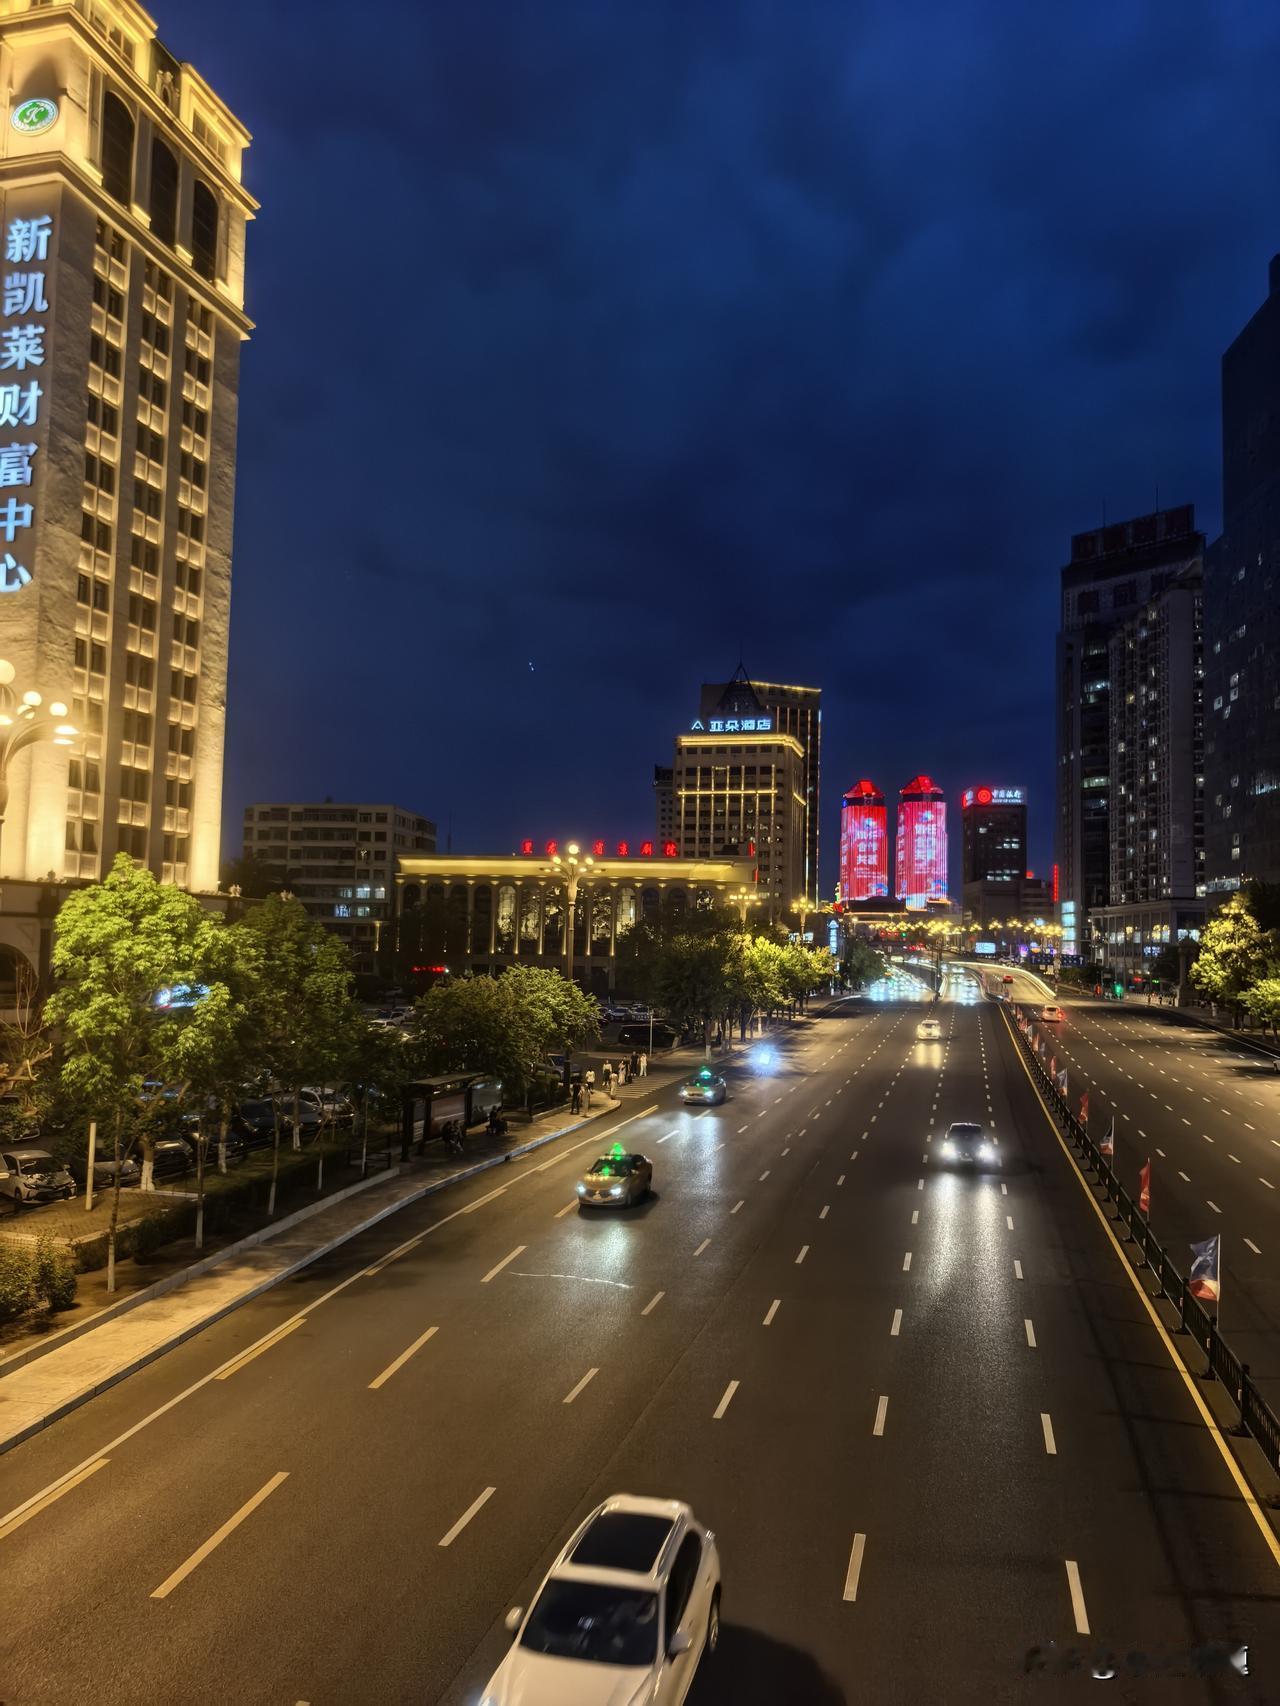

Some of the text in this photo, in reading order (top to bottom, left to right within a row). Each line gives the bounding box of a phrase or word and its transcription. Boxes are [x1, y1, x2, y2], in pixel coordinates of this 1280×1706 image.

[0, 215, 52, 593] 新凯莱财富中心
[709, 719, 771, 732] 亚朵酒店
[992, 789, 1022, 798] 中国银行
[522, 839, 677, 857] 黑龙省京剧院
